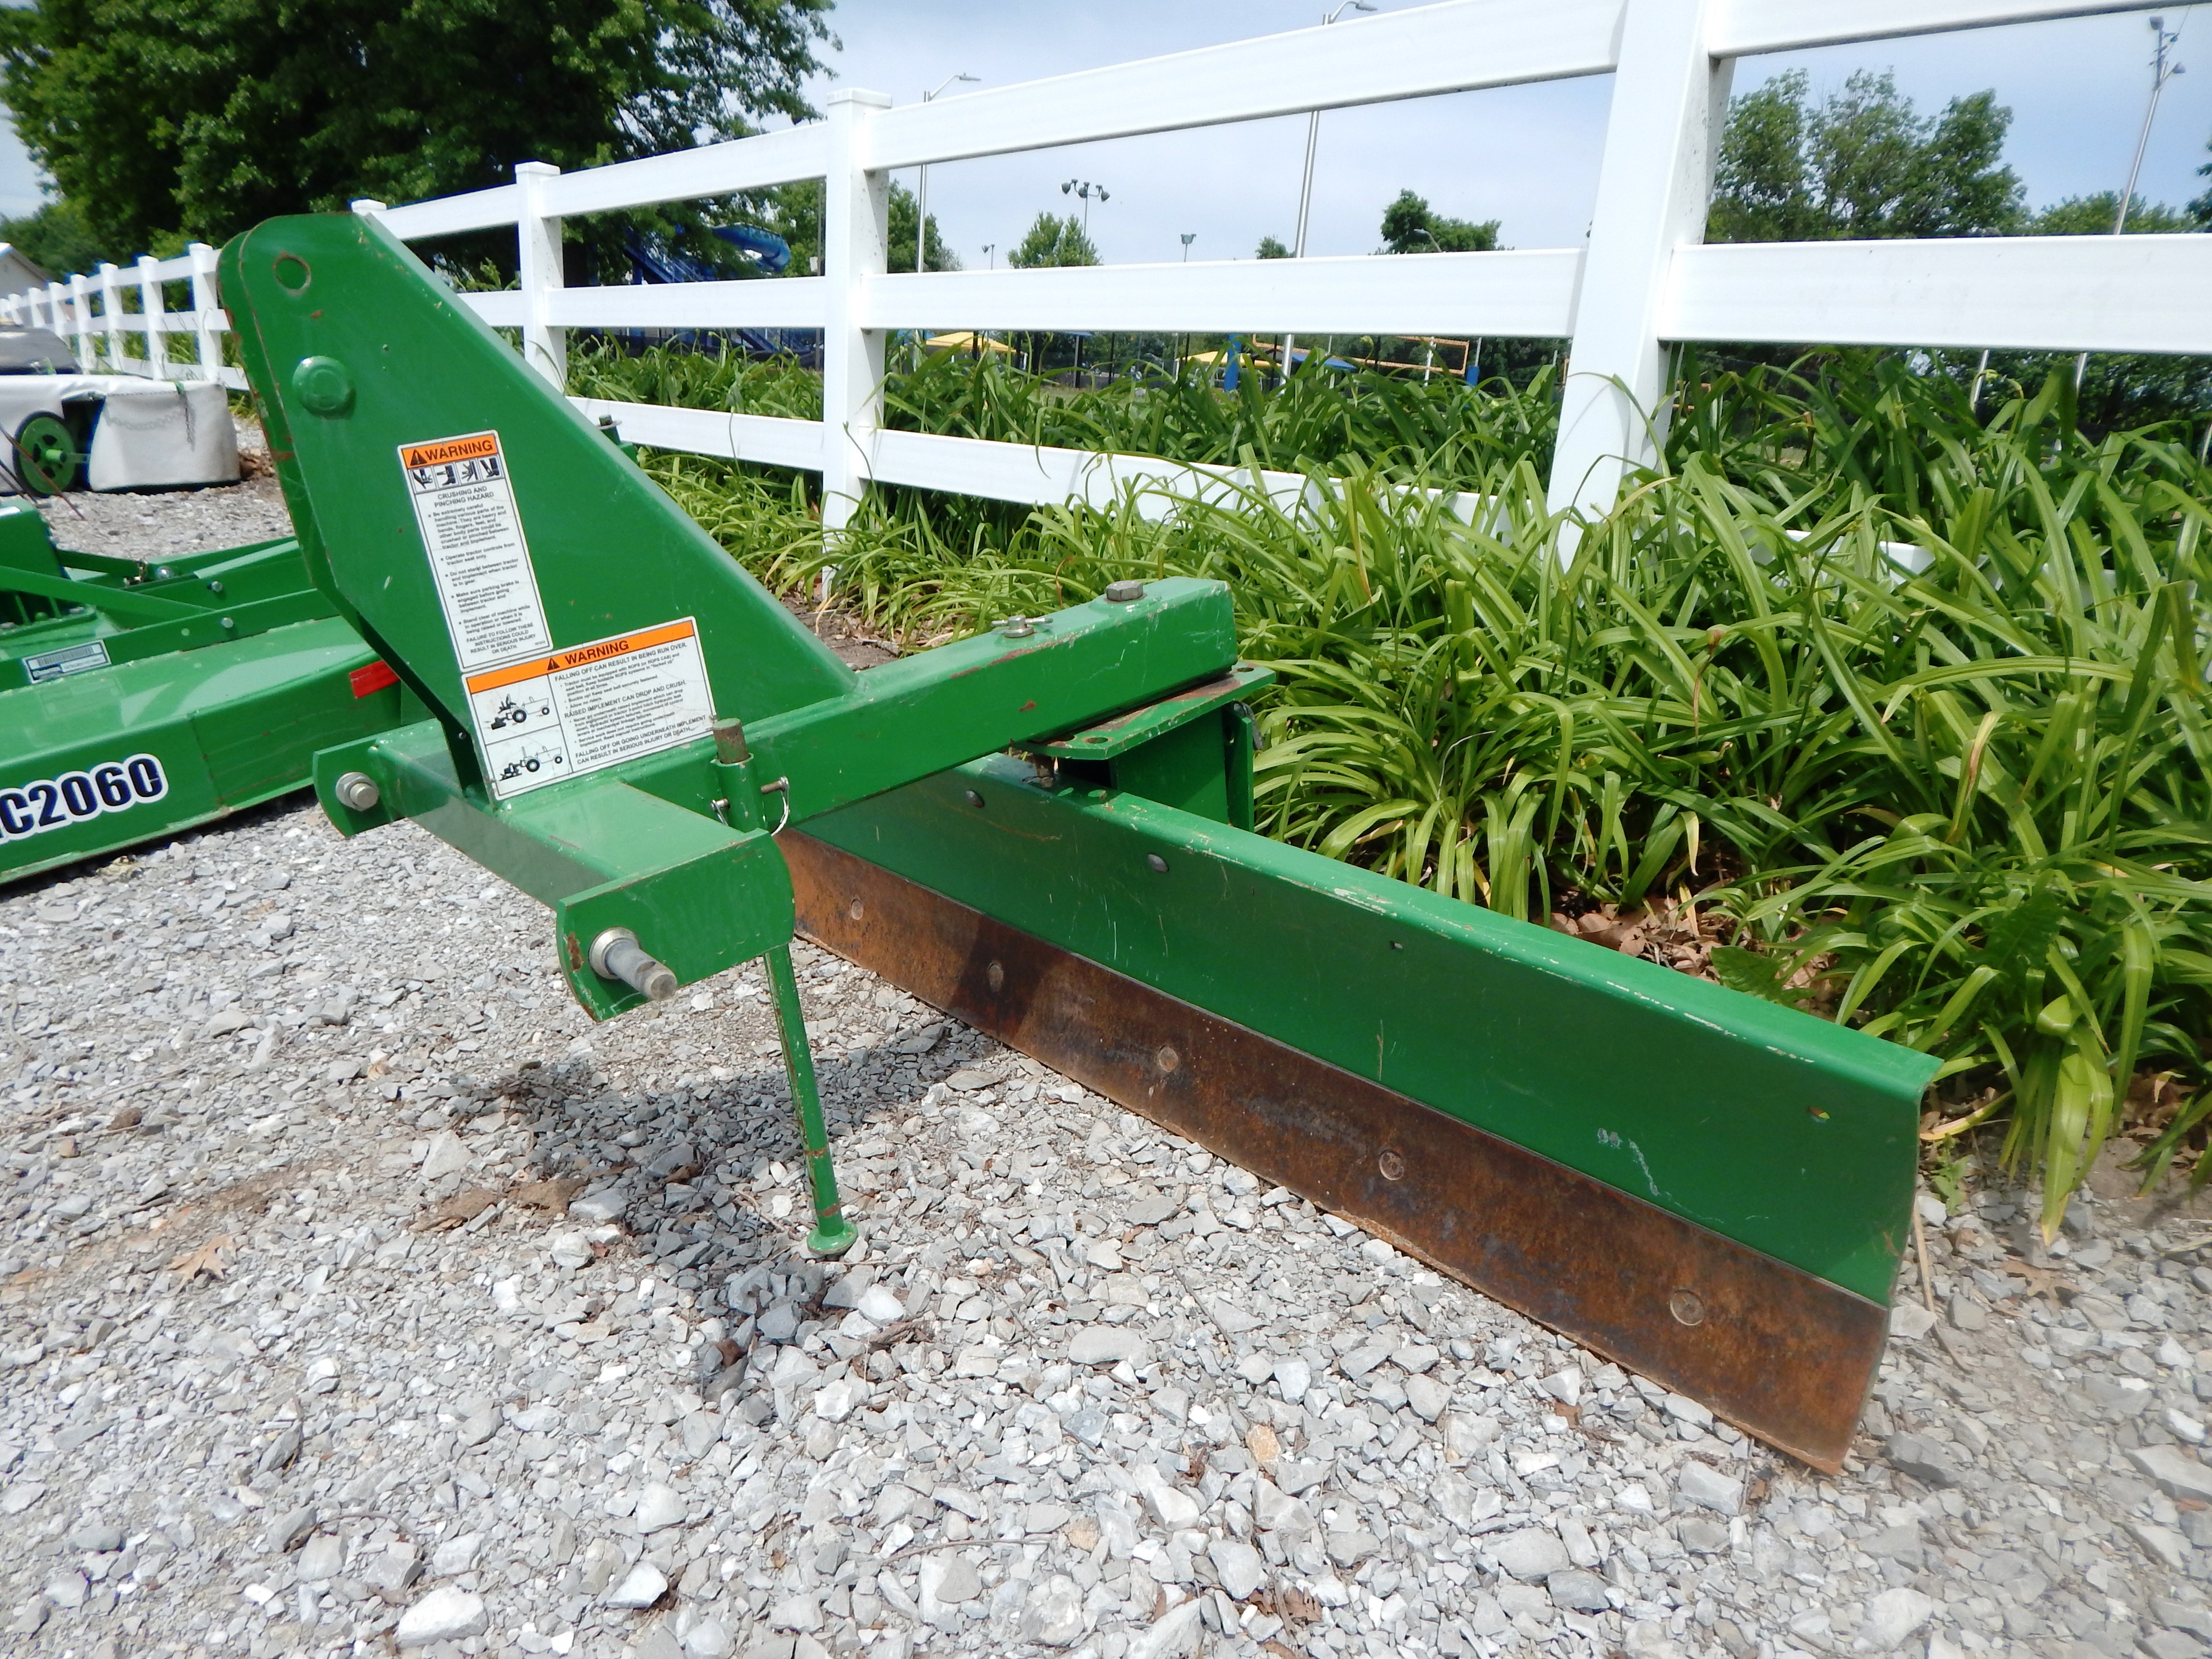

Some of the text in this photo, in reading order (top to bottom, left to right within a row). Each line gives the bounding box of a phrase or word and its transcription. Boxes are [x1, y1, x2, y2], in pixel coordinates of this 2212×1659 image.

[425, 440, 493, 460] WARNING
[434, 492, 494, 507] PINCHING HAZARD
[438, 489, 472, 500] CRUSHING
[467, 634, 487, 642] FAILURE
[496, 627, 517, 635] FOLLOW
[470, 645, 489, 653] RESULT
[496, 638, 518, 647] SERIOUS
[475, 634, 511, 646] INSTRUCTIONS
[565, 640, 629, 665] WARNING
[555, 671, 580, 682] FALLING
[581, 666, 592, 674] OFF
[608, 657, 629, 667] RESULT
[638, 650, 656, 659] BEING
[565, 708, 586, 718] RAISED
[588, 698, 620, 711] IMPLEMENT
[636, 689, 651, 698] DROP
[576, 747, 599, 758] FALLING
[621, 735, 639, 744] GOING
[640, 724, 676, 738] UNDERNEATH
[677, 715, 705, 727] IMPLEMENT
[590, 750, 611, 760] RESULT
[619, 741, 643, 752] SERIOUS
[644, 734, 662, 744] INJURY
[0, 758, 163, 838] C2060
